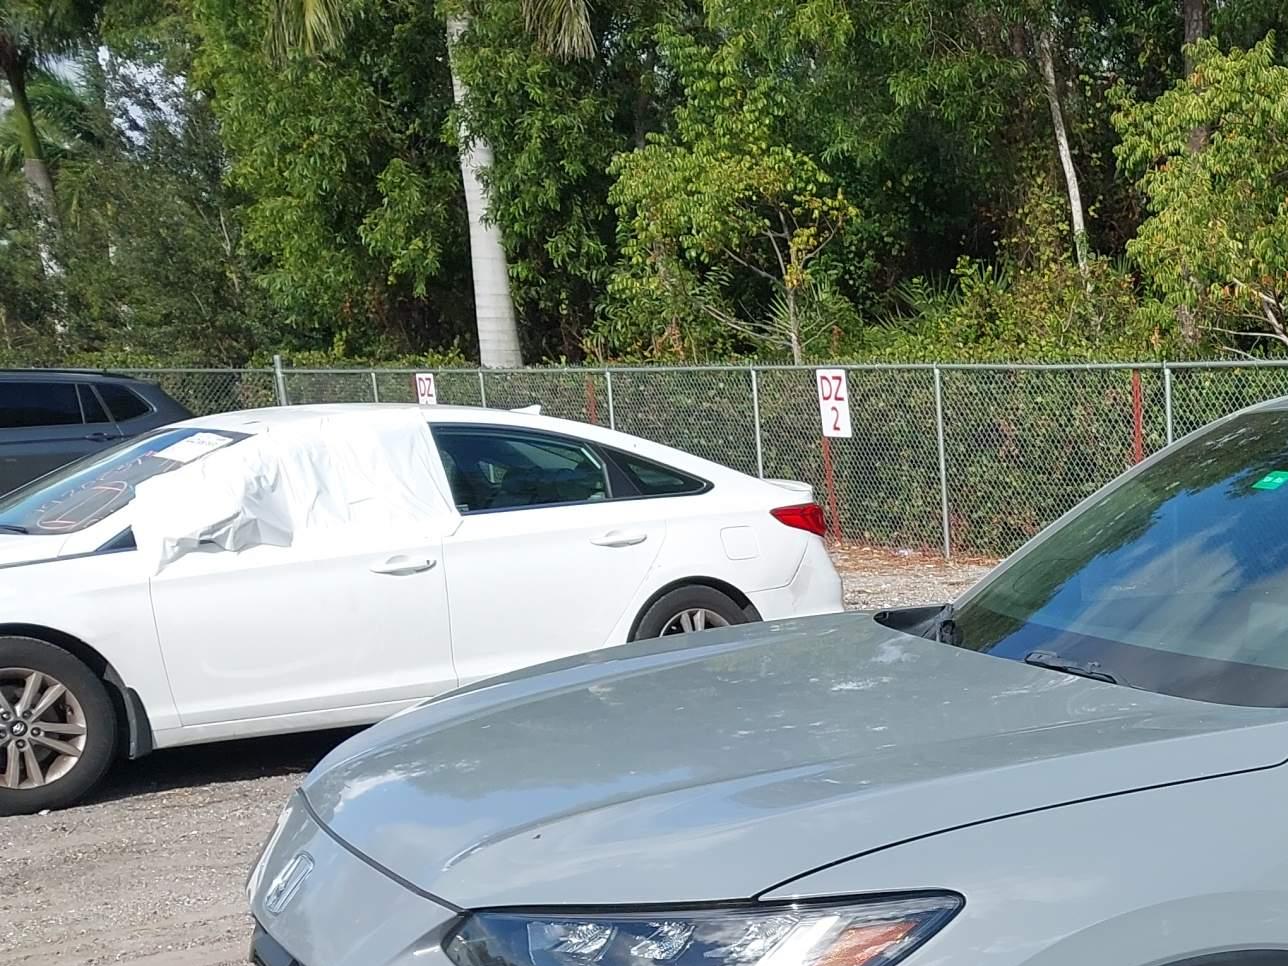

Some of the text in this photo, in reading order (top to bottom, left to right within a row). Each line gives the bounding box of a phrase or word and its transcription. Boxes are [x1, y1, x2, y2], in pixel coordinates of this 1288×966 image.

[418, 377, 434, 397] DZ
[820, 375, 845, 401] DZ
[831, 406, 841, 431] 2
